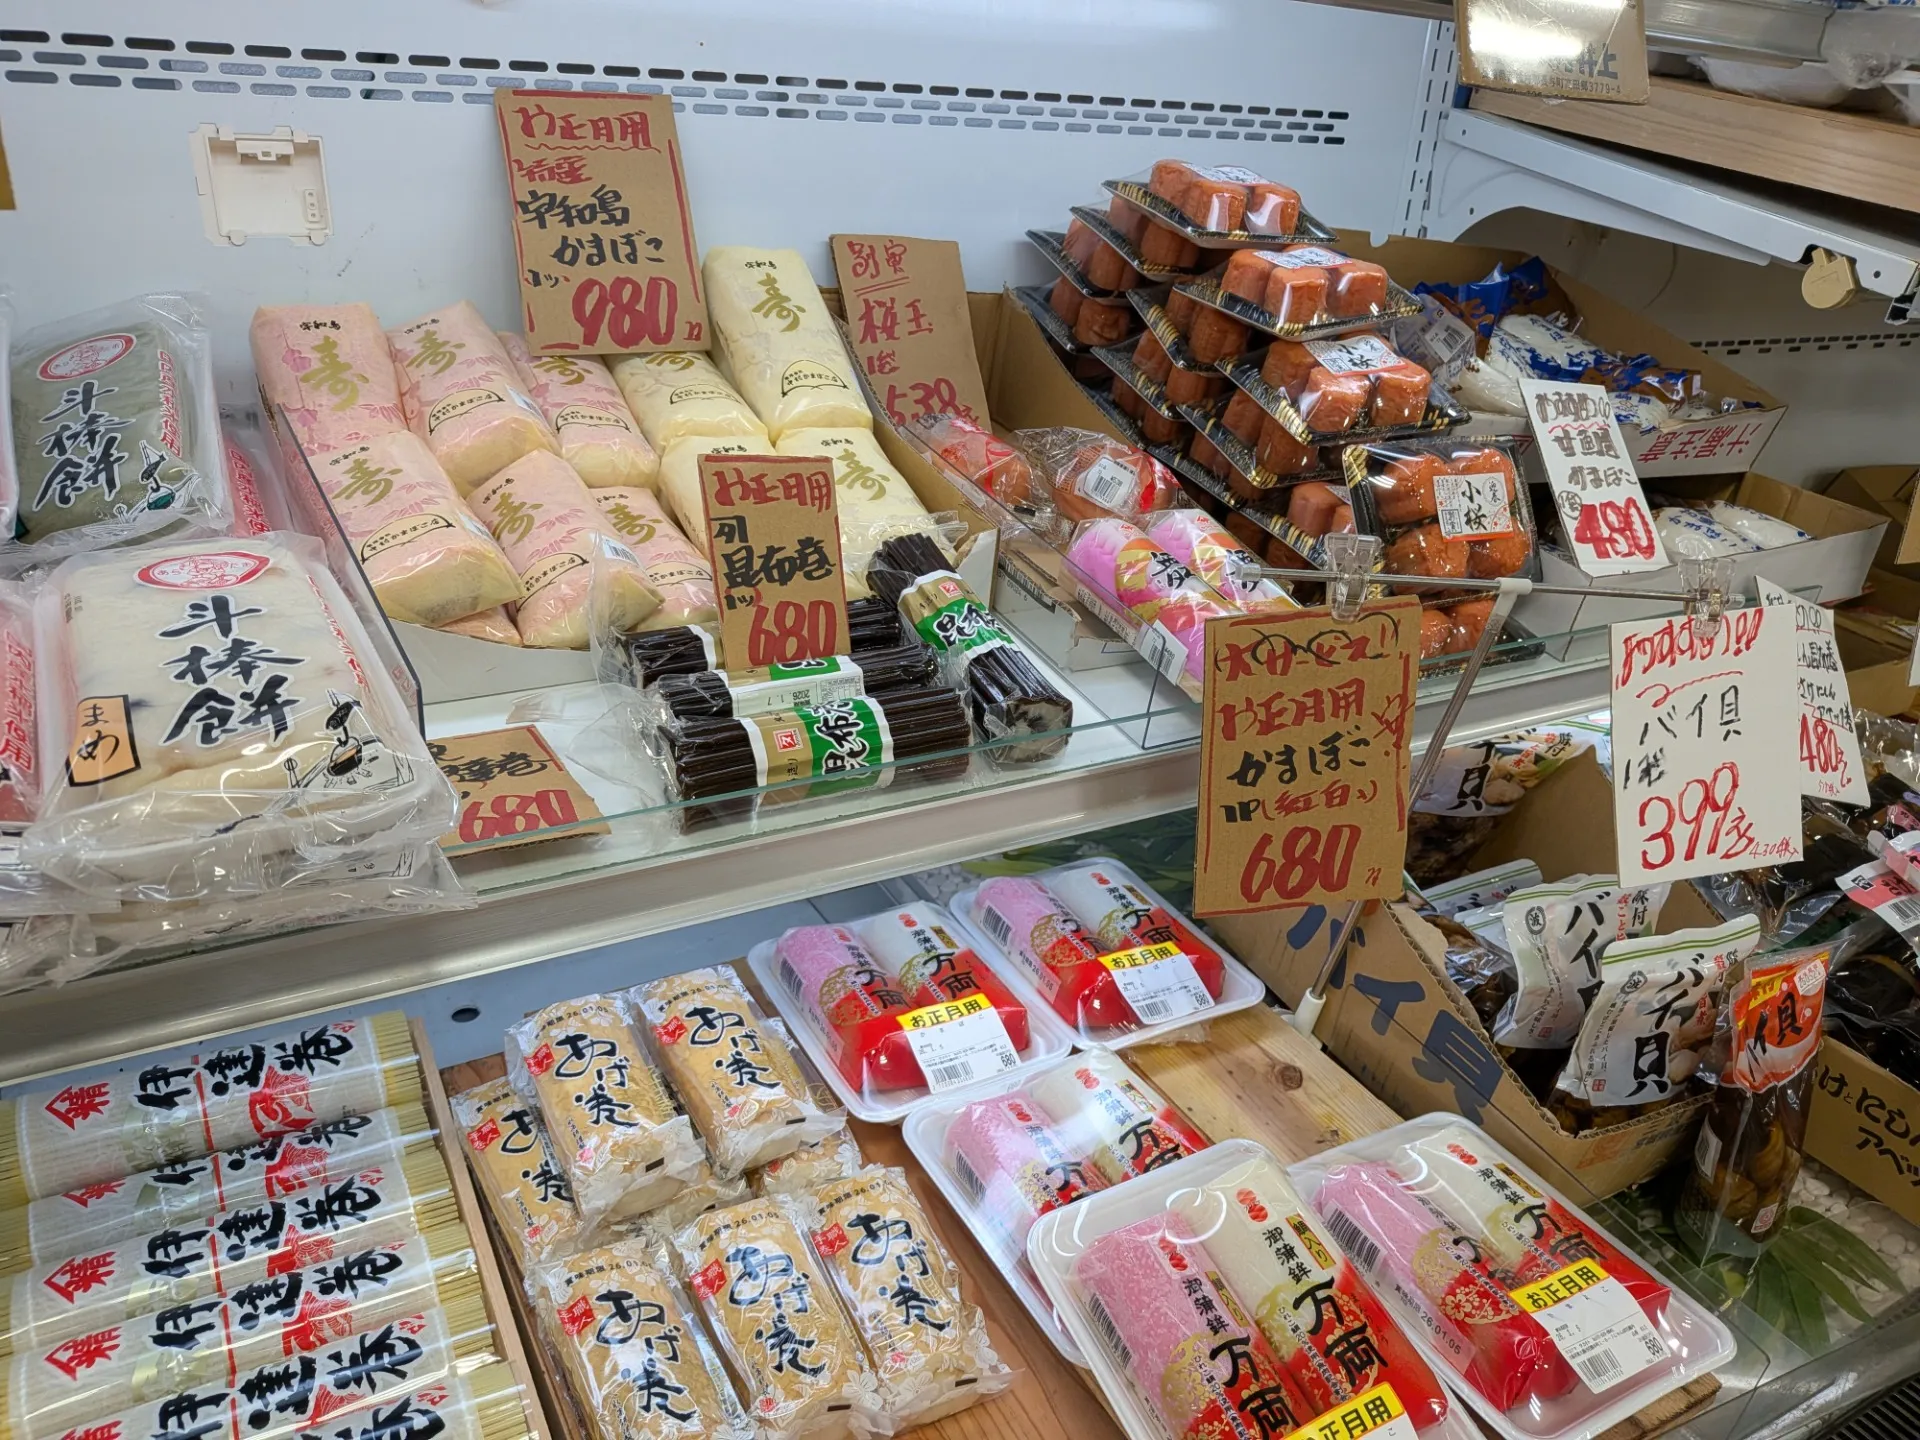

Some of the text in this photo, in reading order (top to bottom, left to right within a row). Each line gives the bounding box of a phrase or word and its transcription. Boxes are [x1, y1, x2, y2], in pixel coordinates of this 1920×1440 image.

[517, 184, 630, 229] 宇和島
[550, 230, 666, 267] かまぼこ
[572, 276, 679, 349] 980
[752, 272, 806, 333] 寿
[300, 336, 369, 412] 寿
[406, 329, 466, 376] 寿
[36, 382, 134, 508] 斗棒餅
[836, 449, 891, 502] 寿
[332, 458, 403, 507] 寿
[1461, 480, 1488, 532] 小桜
[1568, 466, 1638, 491] かまぼこ
[499, 493, 544, 547] 寿
[606, 502, 662, 546] 寿
[1574, 497, 1656, 560] 480
[721, 536, 836, 588] 昆布巻
[748, 600, 837, 666] 680
[160, 596, 306, 747] 斗棒餅
[78, 705, 119, 763] まめ
[1639, 685, 1742, 746] バイ貝
[1800, 713, 1839, 774] 480
[1226, 725, 1371, 788] かまぼこ
[459, 789, 580, 843] 680
[1639, 761, 1740, 871] 399
[1240, 824, 1361, 903] 680
[924, 951, 982, 999] 万両
[1112, 946, 1174, 970] お正月用
[1564, 890, 1612, 1014] バイ
[911, 998, 983, 1028] お正月用
[1625, 952, 1705, 1099] バイ貝
[133, 1023, 354, 1112] 伊達巻
[685, 1006, 782, 1090] あげ巻
[555, 1033, 639, 1127] あげ巻
[500, 1108, 576, 1204] あ巻
[1478, 1166, 1526, 1206] 御蒲鉾
[144, 1174, 383, 1280] 伊達巻
[1261, 1226, 1312, 1285] 御蒲鉾
[1292, 1217, 1330, 1265] 鯛入り
[1514, 1202, 1608, 1262] 万両
[150, 1247, 404, 1351] 伊達巻
[847, 1214, 953, 1331] あげ巻
[1526, 1265, 1601, 1309] お正月用
[725, 1247, 828, 1376] あげ巻
[1184, 1278, 1230, 1336] 御蒲鉾
[1292, 1276, 1389, 1389] 万両
[1420, 1309, 1462, 1356] 26.01.05
[595, 1290, 697, 1422] あげ巻
[1210, 1334, 1303, 1440] 万両
[1301, 1395, 1393, 1440] 正月用
